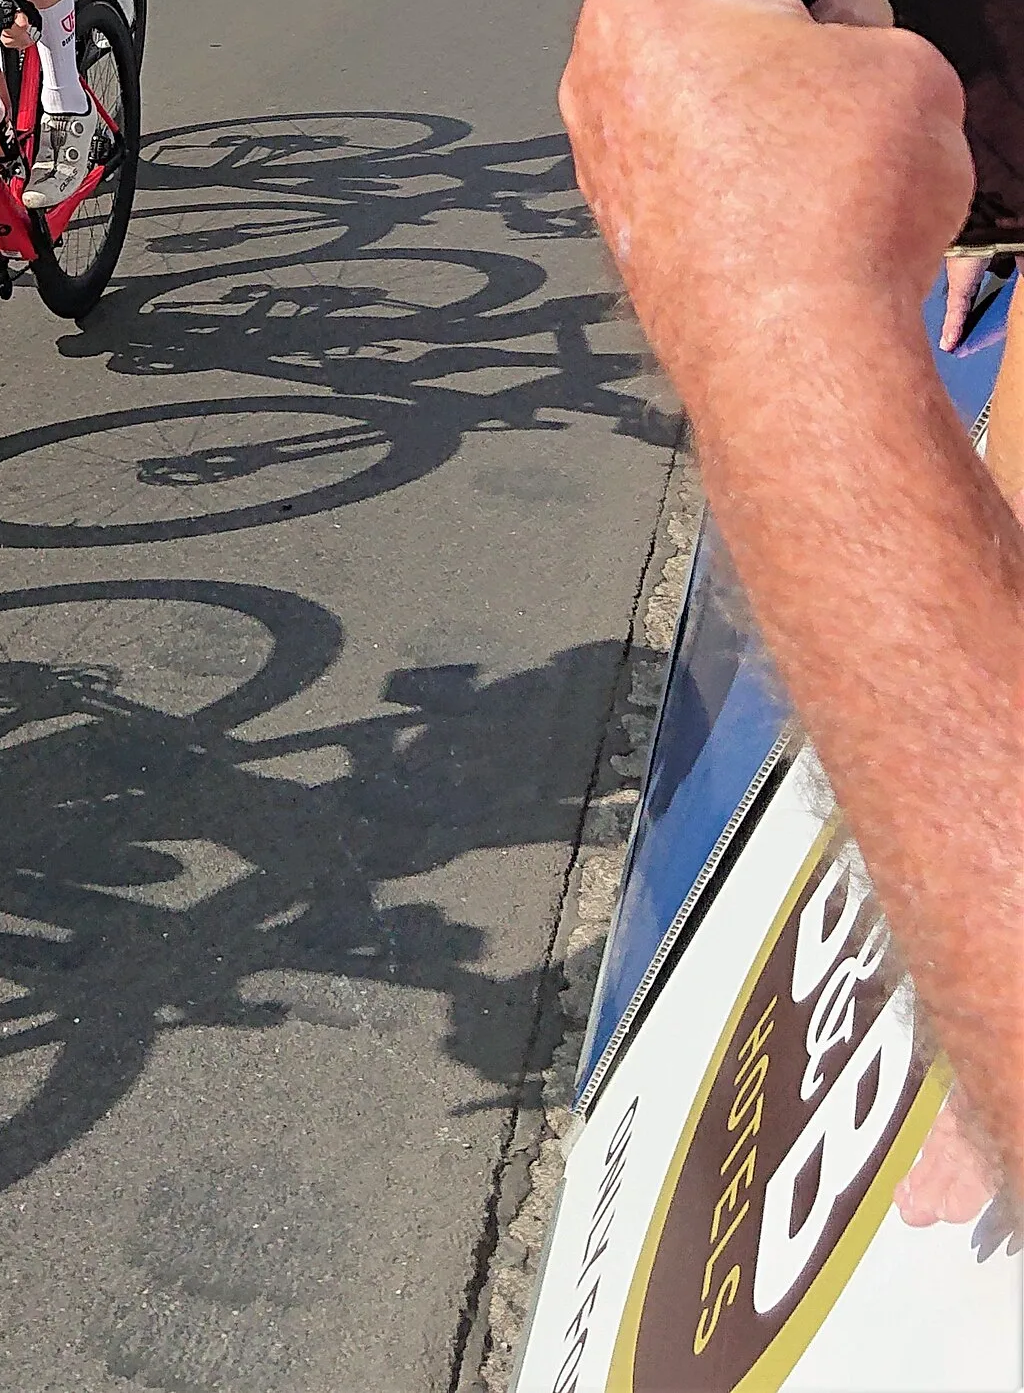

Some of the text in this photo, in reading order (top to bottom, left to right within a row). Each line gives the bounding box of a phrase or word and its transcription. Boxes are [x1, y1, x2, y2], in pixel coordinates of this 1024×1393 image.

[553, 1095, 639, 1393] ONLY FO
[692, 994, 778, 1356] HOTELS
